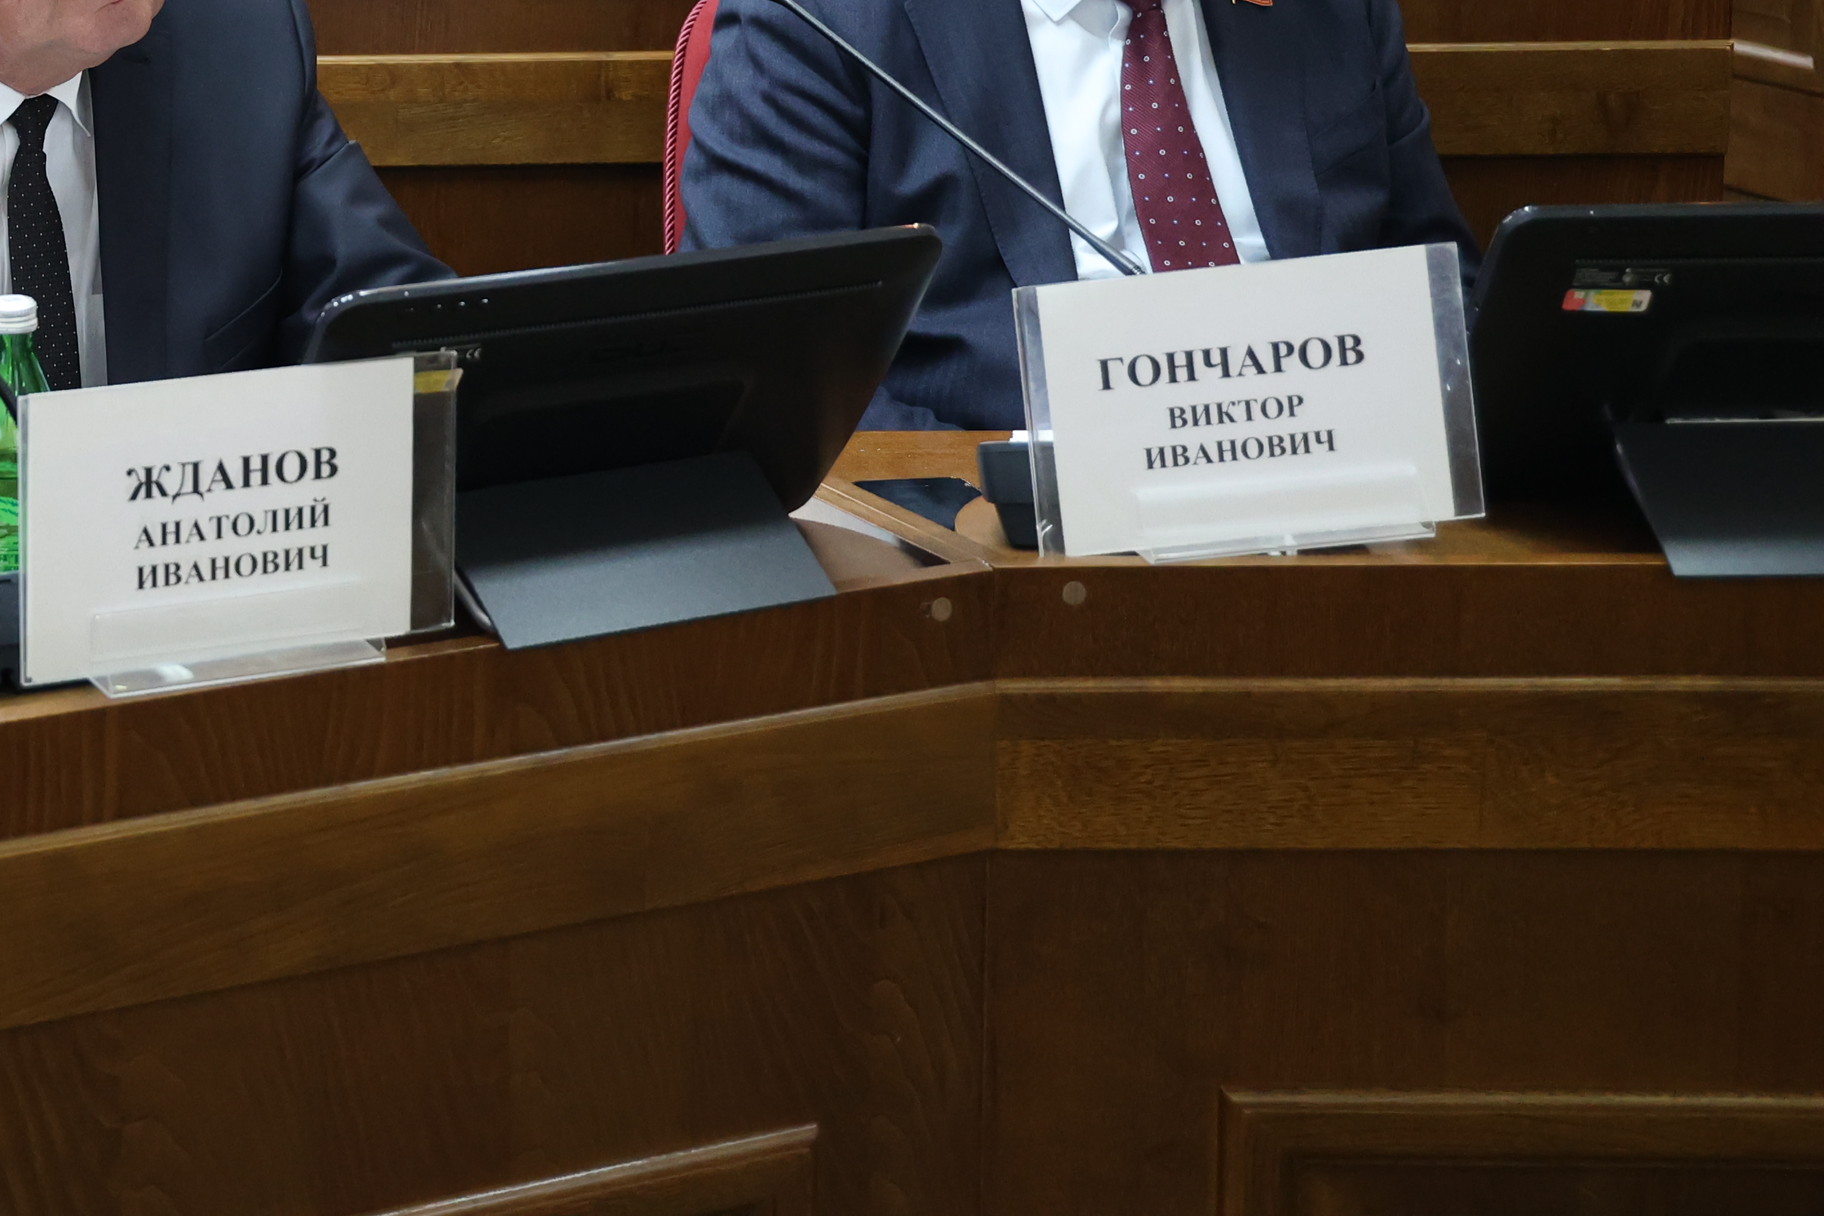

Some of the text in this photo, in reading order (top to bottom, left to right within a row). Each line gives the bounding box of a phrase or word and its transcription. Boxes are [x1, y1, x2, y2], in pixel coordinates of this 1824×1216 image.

[1096, 332, 1366, 392] ГОНЧАРОВ
[1166, 394, 1305, 430] ВИКТОР
[125, 445, 340, 504] ЖДАНОВ
[1143, 428, 1337, 471] ИВАНОВИЧ
[133, 497, 332, 551] АНАТОЛИЙ
[135, 543, 330, 592] ИВАНОВИЧ
